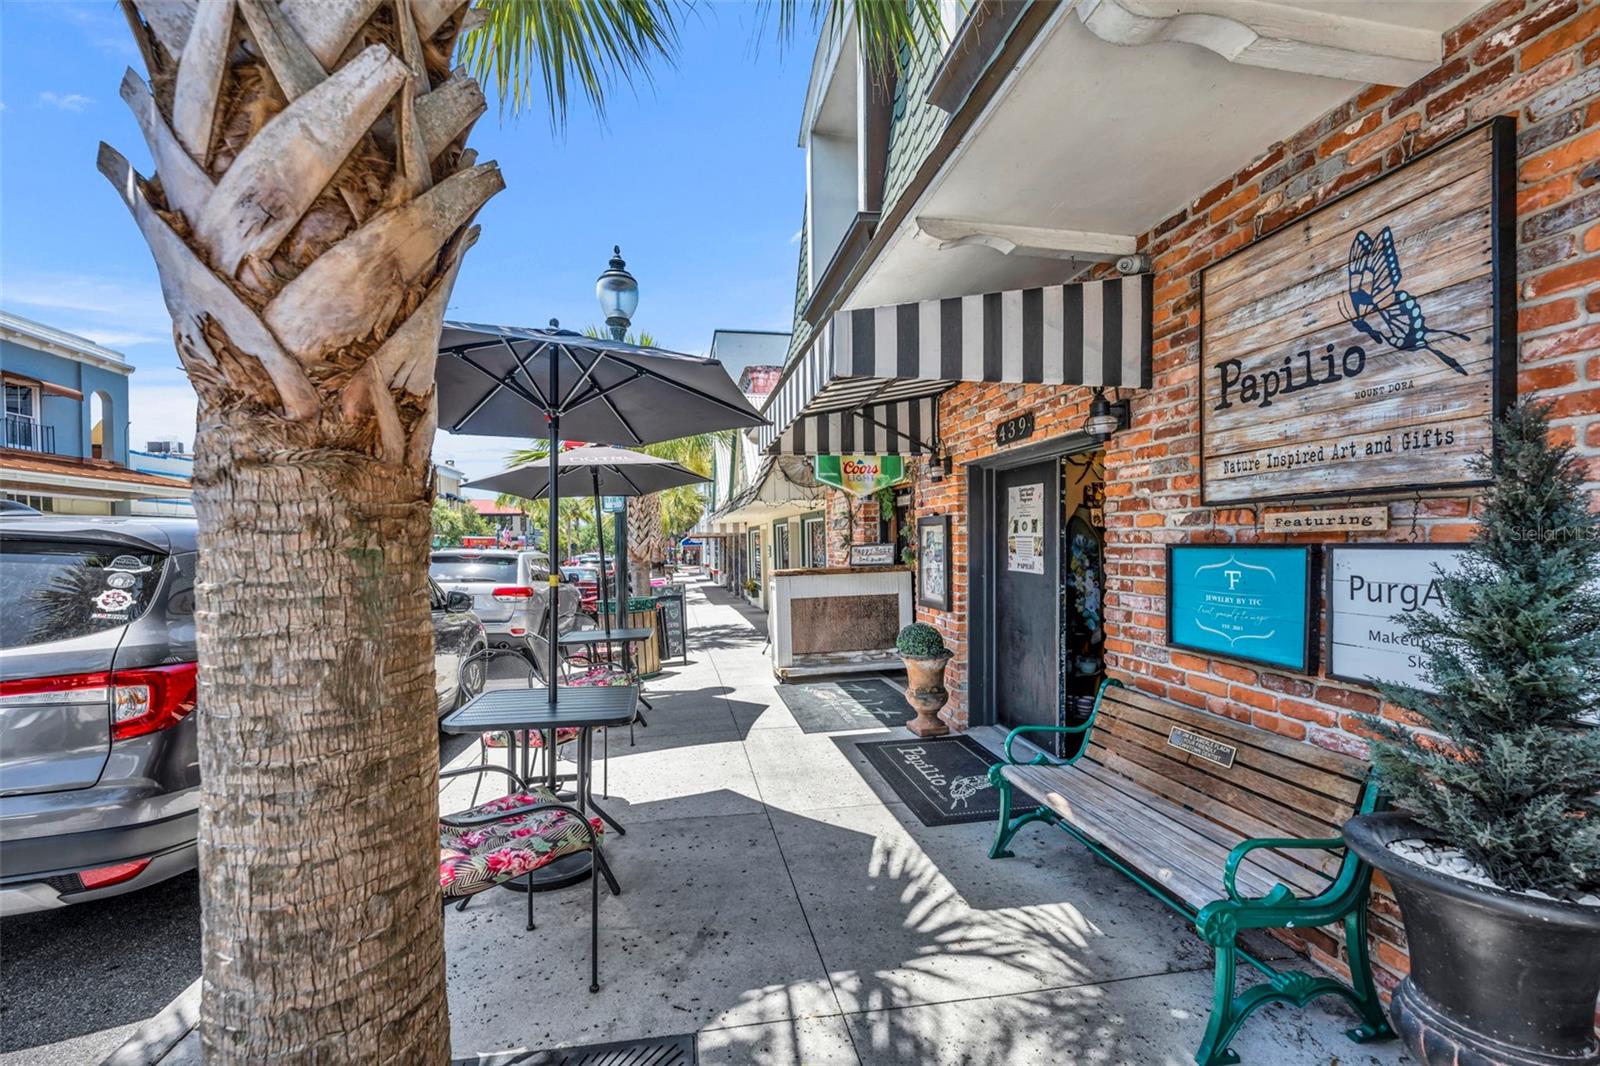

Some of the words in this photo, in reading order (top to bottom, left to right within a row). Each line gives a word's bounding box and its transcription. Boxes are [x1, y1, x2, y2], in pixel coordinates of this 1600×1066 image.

[1214, 343, 1367, 411] Papilio
[1354, 386, 1385, 400] MOUNT
[1388, 380, 1415, 395] DORA
[998, 416, 1027, 442] 439
[1223, 458, 1261, 475] Nature
[1266, 446, 1325, 470] Inspired
[1331, 442, 1357, 461] Art
[1365, 436, 1393, 454] and
[1402, 428, 1456, 450] Gifts
[842, 460, 880, 475] Coors
[847, 474, 875, 482] LIGHT
[1273, 514, 1373, 528] Featuring
[1205, 594, 1233, 604] JEWELRY
[1236, 597, 1247, 605] BY
[897, 745, 948, 786] Papilio
